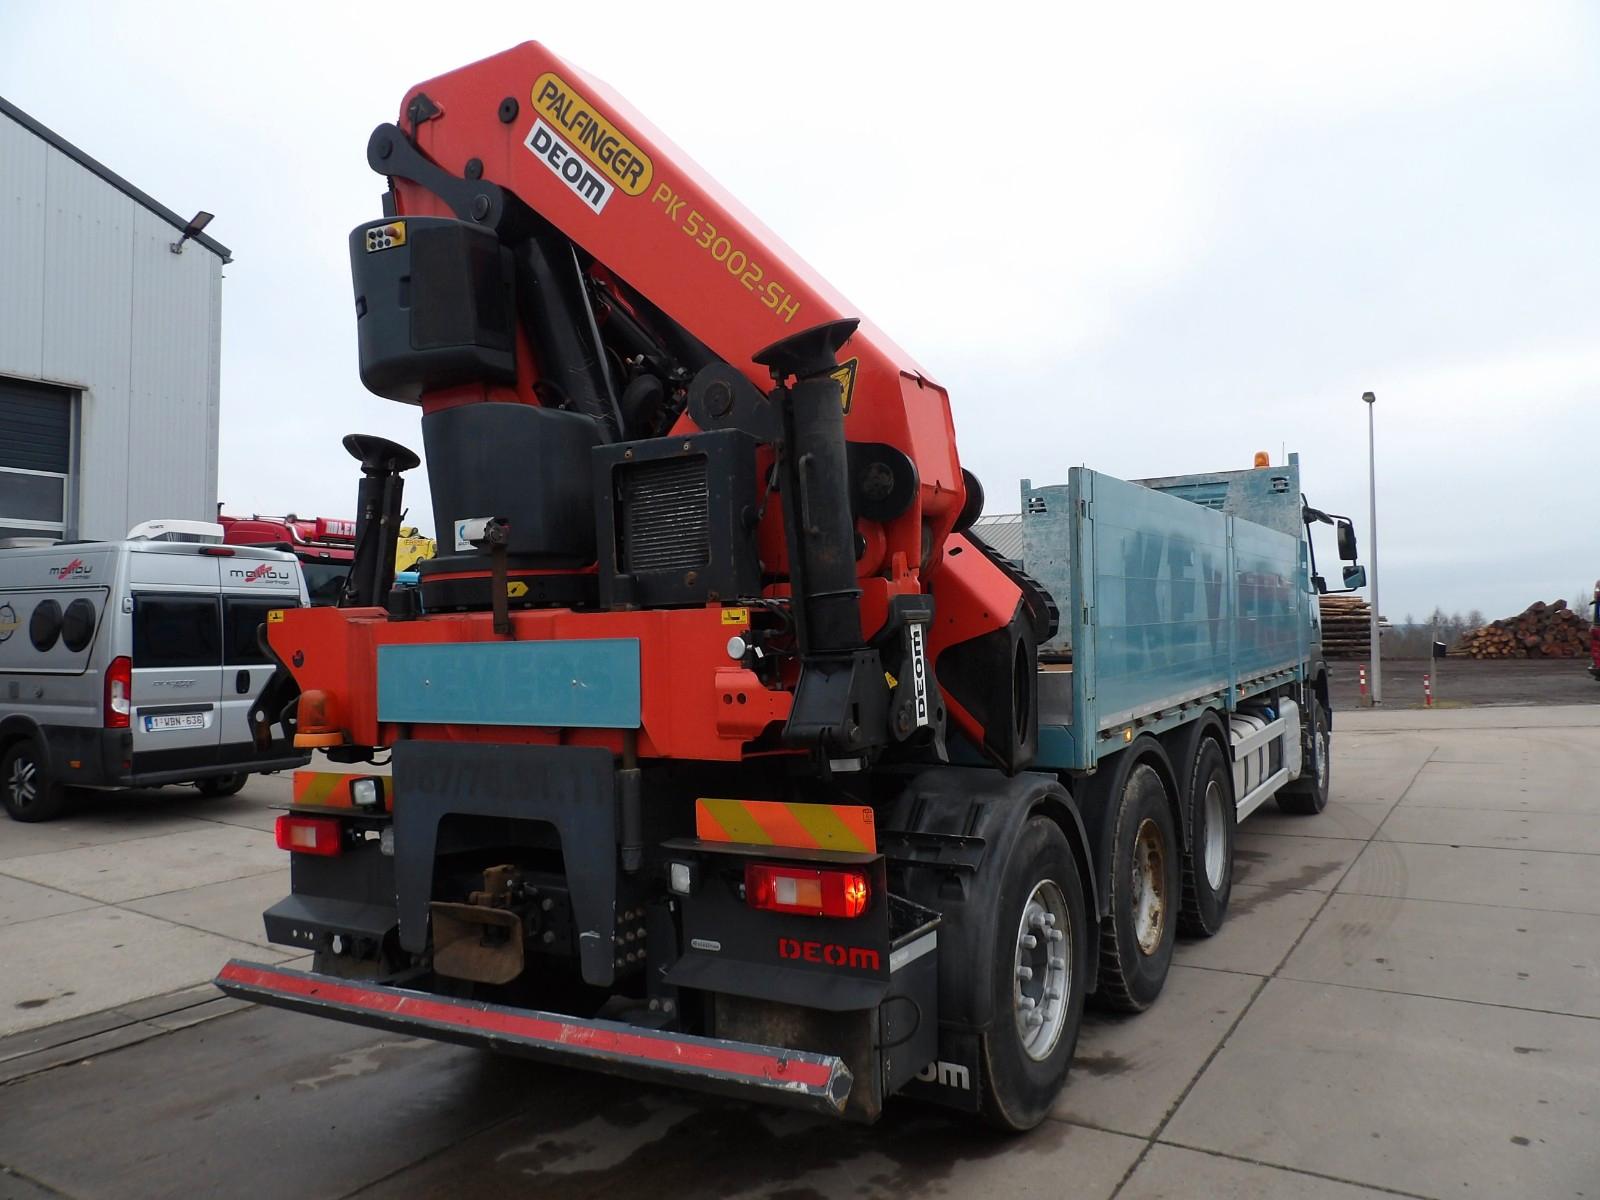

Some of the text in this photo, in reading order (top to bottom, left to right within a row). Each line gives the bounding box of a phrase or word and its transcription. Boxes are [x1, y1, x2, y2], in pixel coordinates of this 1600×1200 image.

[537, 80, 645, 189] PALFINGER
[651, 182, 801, 323] PK 53002-SH
